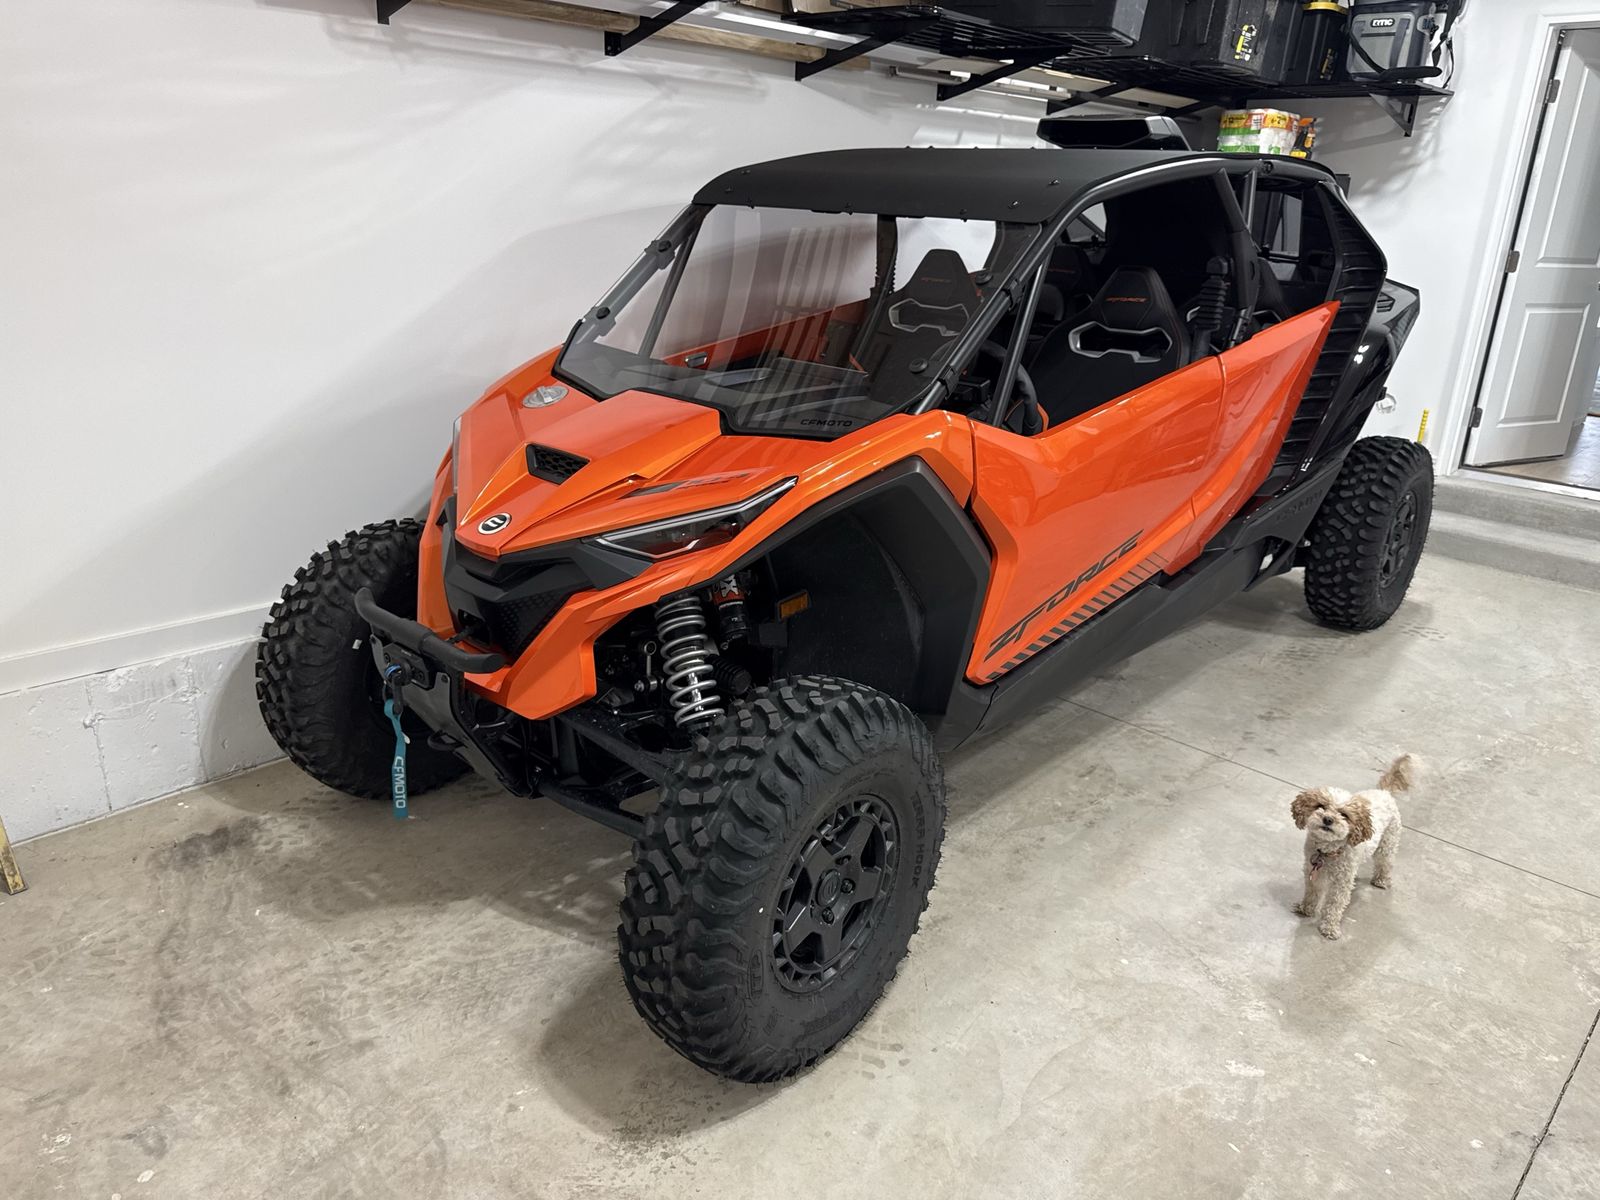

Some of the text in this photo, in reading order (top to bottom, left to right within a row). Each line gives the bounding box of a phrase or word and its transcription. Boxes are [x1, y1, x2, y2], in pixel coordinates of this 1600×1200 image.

[800, 418, 853, 427] CFMOTO
[394, 756, 406, 808] CFMOTO
[911, 844, 925, 888] HOOK
